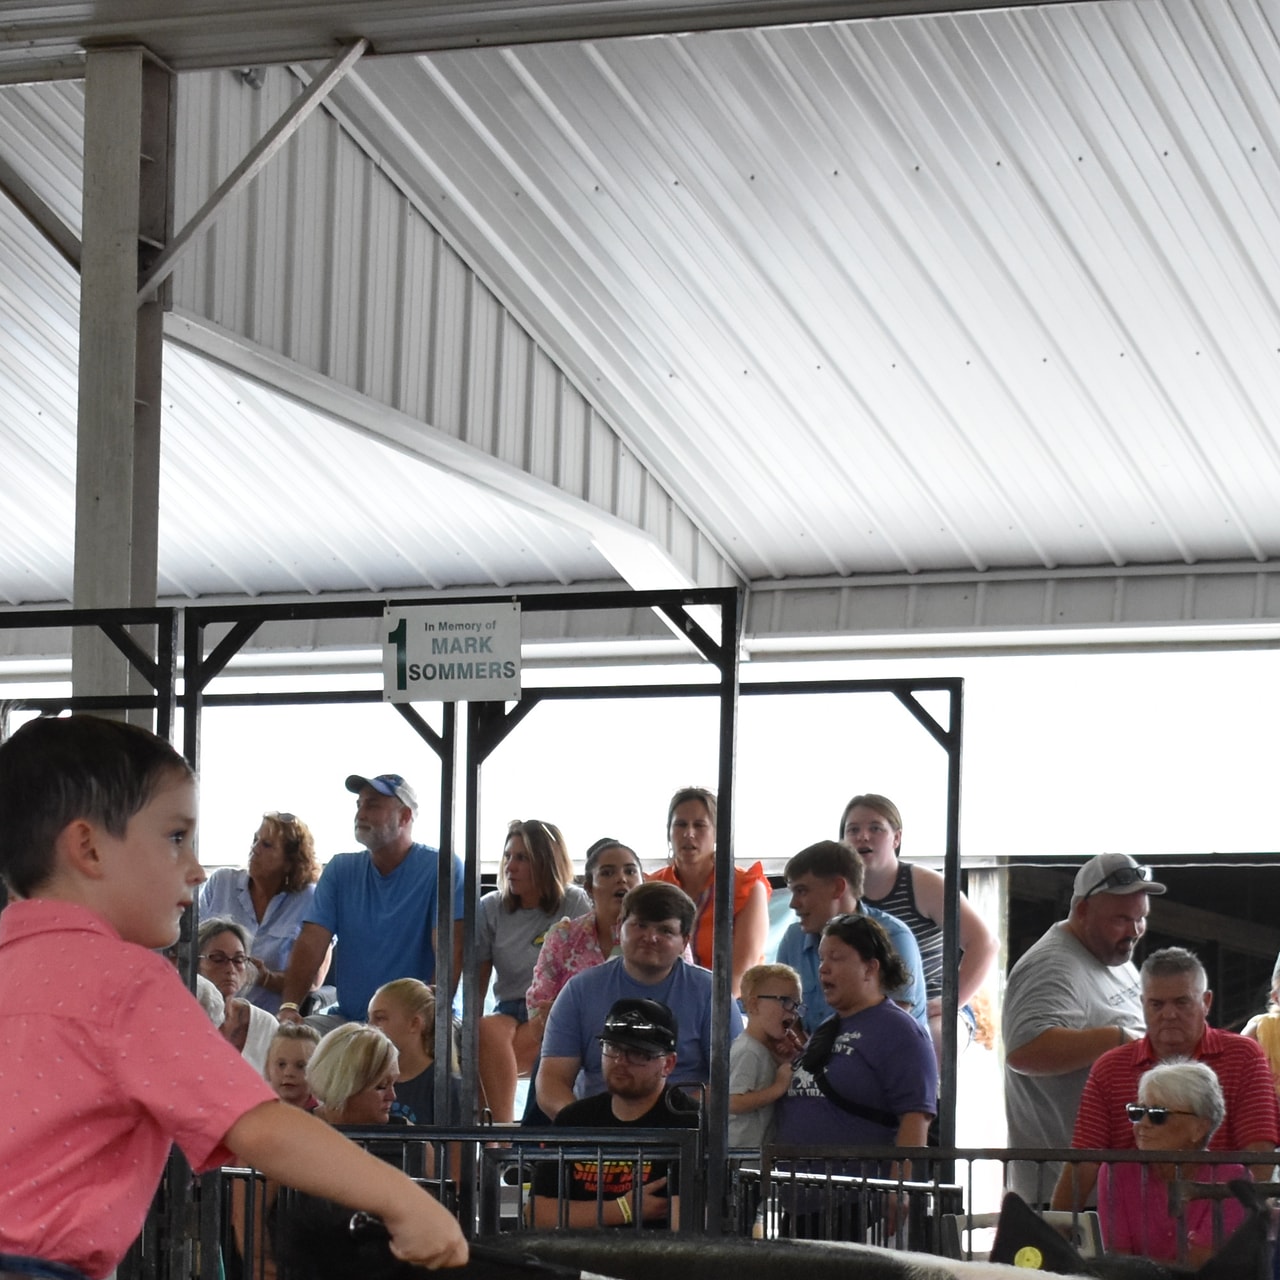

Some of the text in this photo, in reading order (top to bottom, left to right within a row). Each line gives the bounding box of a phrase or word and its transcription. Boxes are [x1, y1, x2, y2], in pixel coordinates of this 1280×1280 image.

[424, 620, 496, 633] In Memory of
[388, 618, 407, 690] 1
[431, 636, 493, 655] MARK
[408, 661, 516, 681] SOMMERS
